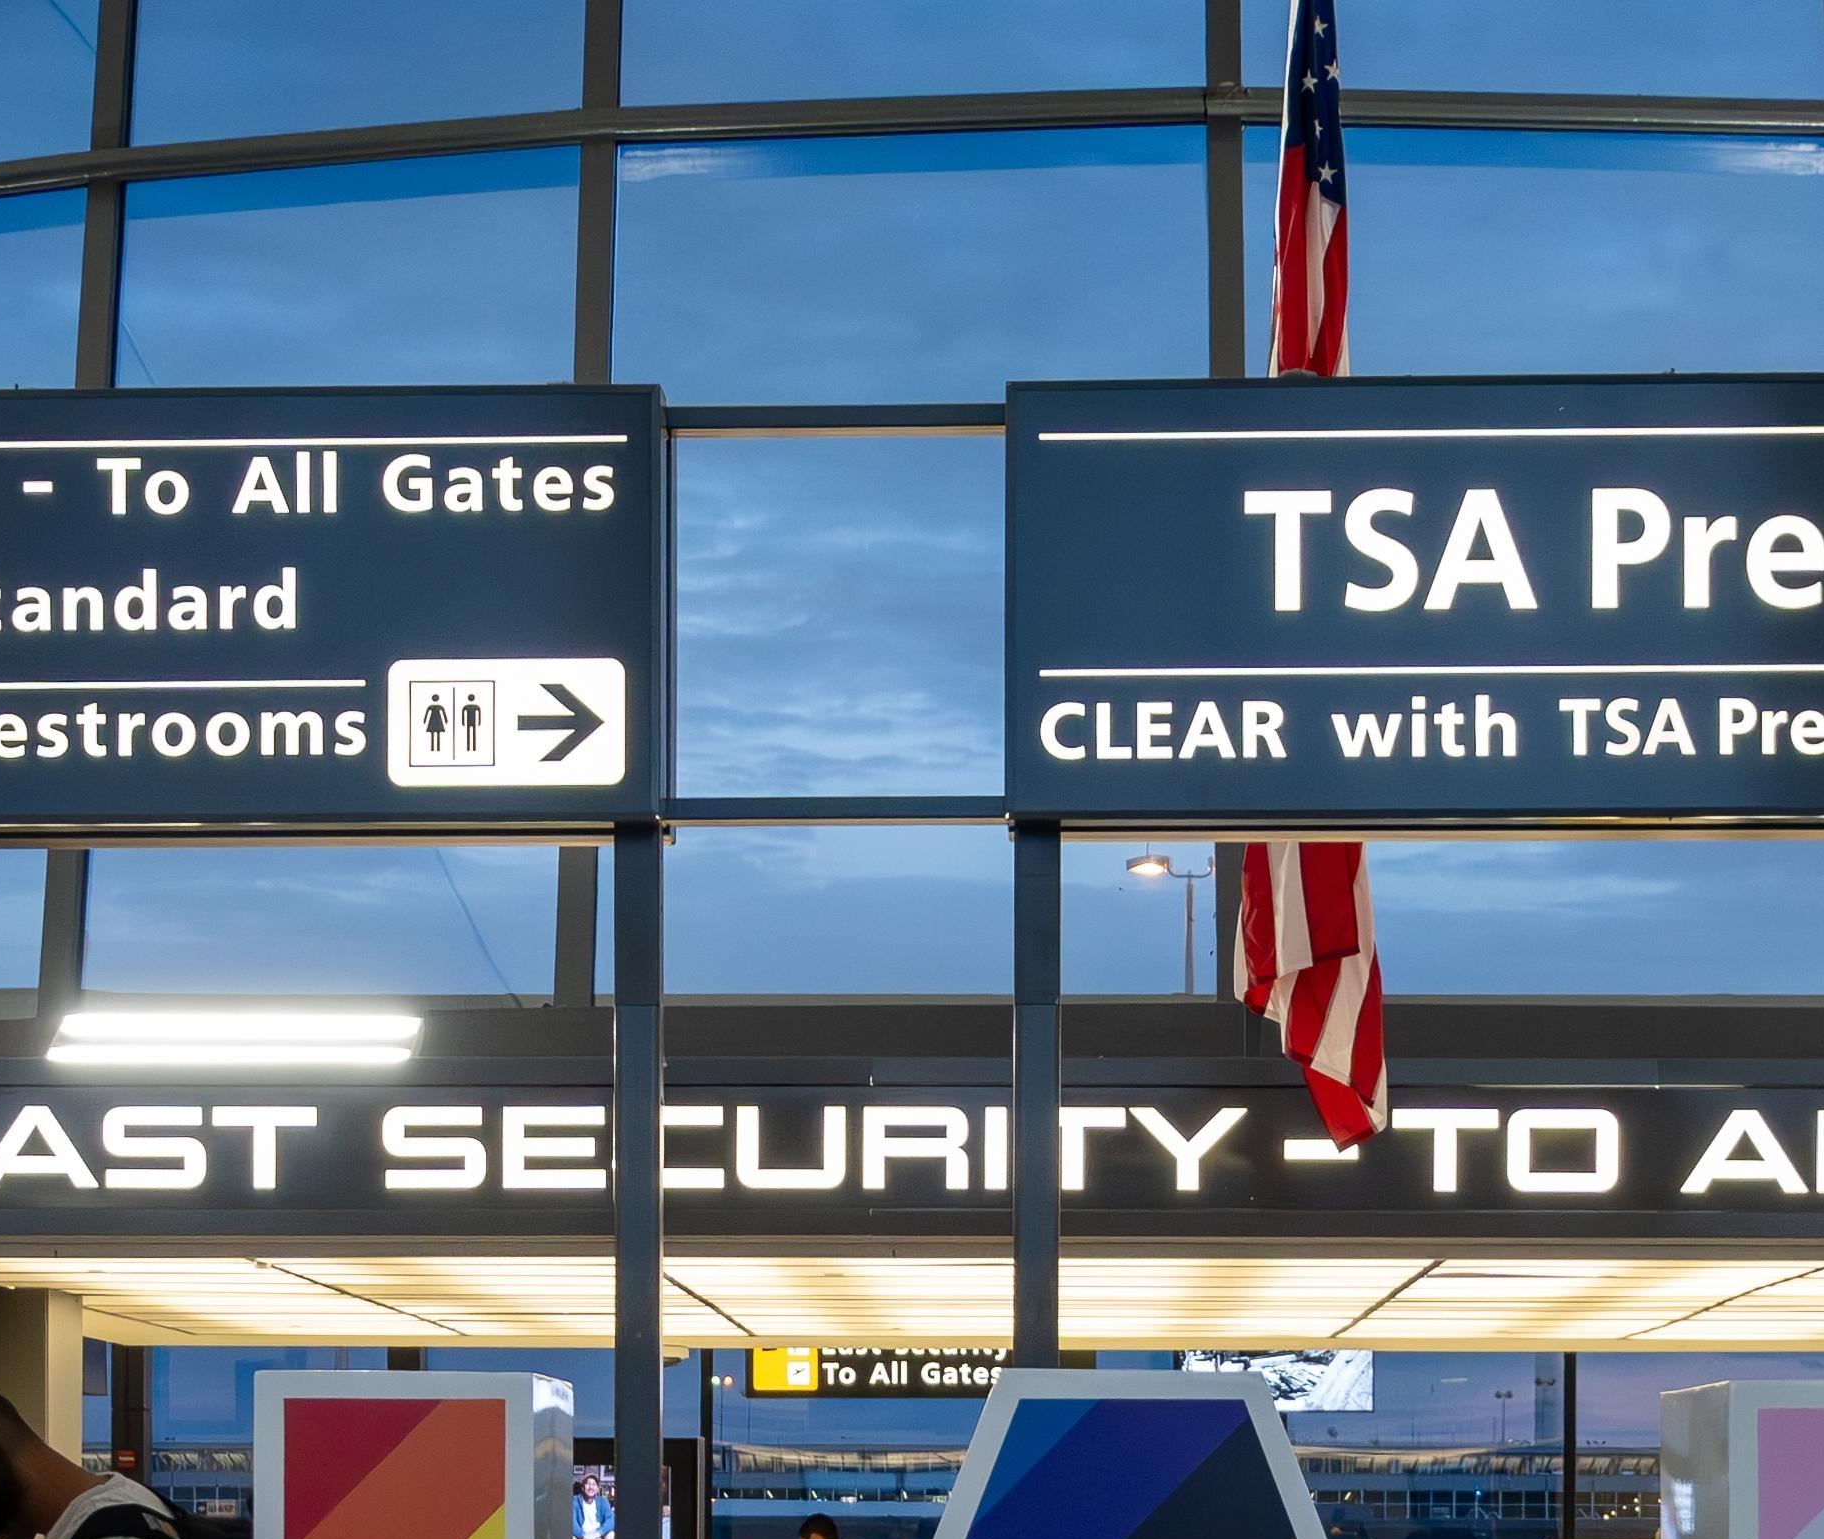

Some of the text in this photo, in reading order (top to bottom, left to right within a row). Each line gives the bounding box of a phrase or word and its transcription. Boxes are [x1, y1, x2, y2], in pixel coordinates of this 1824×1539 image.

[22, 480, 54, 493] -
[96, 457, 190, 516] To
[231, 451, 338, 514] All
[382, 453, 615, 514] Gates
[1243, 487, 1538, 612] TSA
[1039, 700, 1287, 761] CLEAR
[1330, 694, 1517, 758] with
[1558, 697, 1697, 756] TSA
[381, 1105, 1248, 1191] SECURITY
[1390, 1108, 1619, 1193] TO
[821, 1360, 1003, 1385] To All Gates
